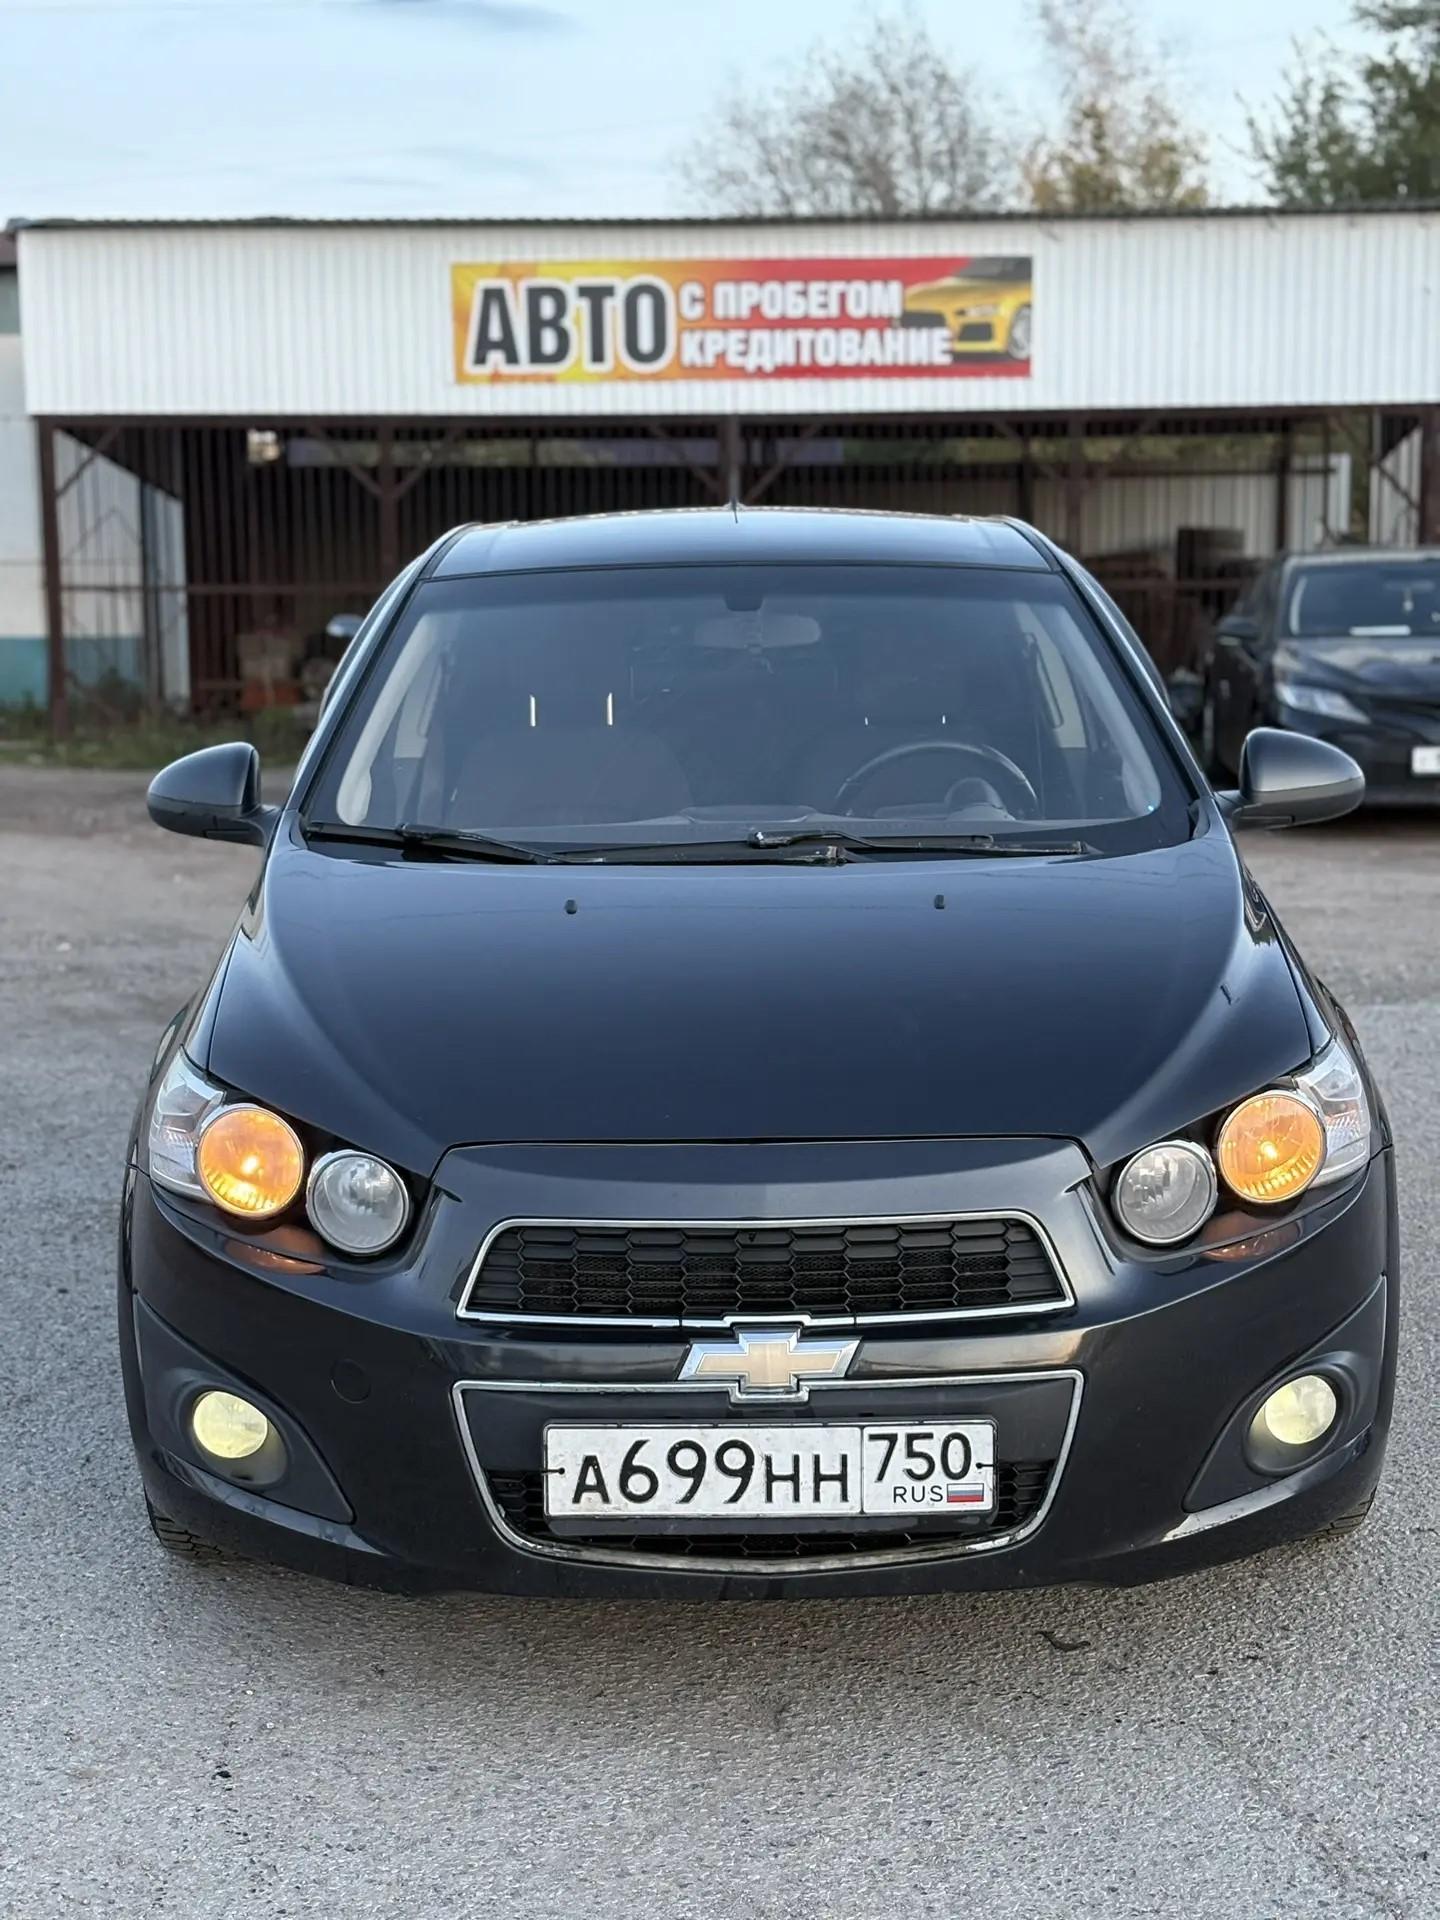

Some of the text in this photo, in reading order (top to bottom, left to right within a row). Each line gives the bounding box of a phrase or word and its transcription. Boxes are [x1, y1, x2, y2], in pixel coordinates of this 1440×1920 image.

[679, 280, 903, 320] С ПРОБЕГОМ
[469, 281, 672, 372] АВТО
[681, 328, 953, 372] КРЕДИТОВАНИЕ
[868, 1433, 971, 1482] 750
[893, 1485, 944, 1503] RUS
